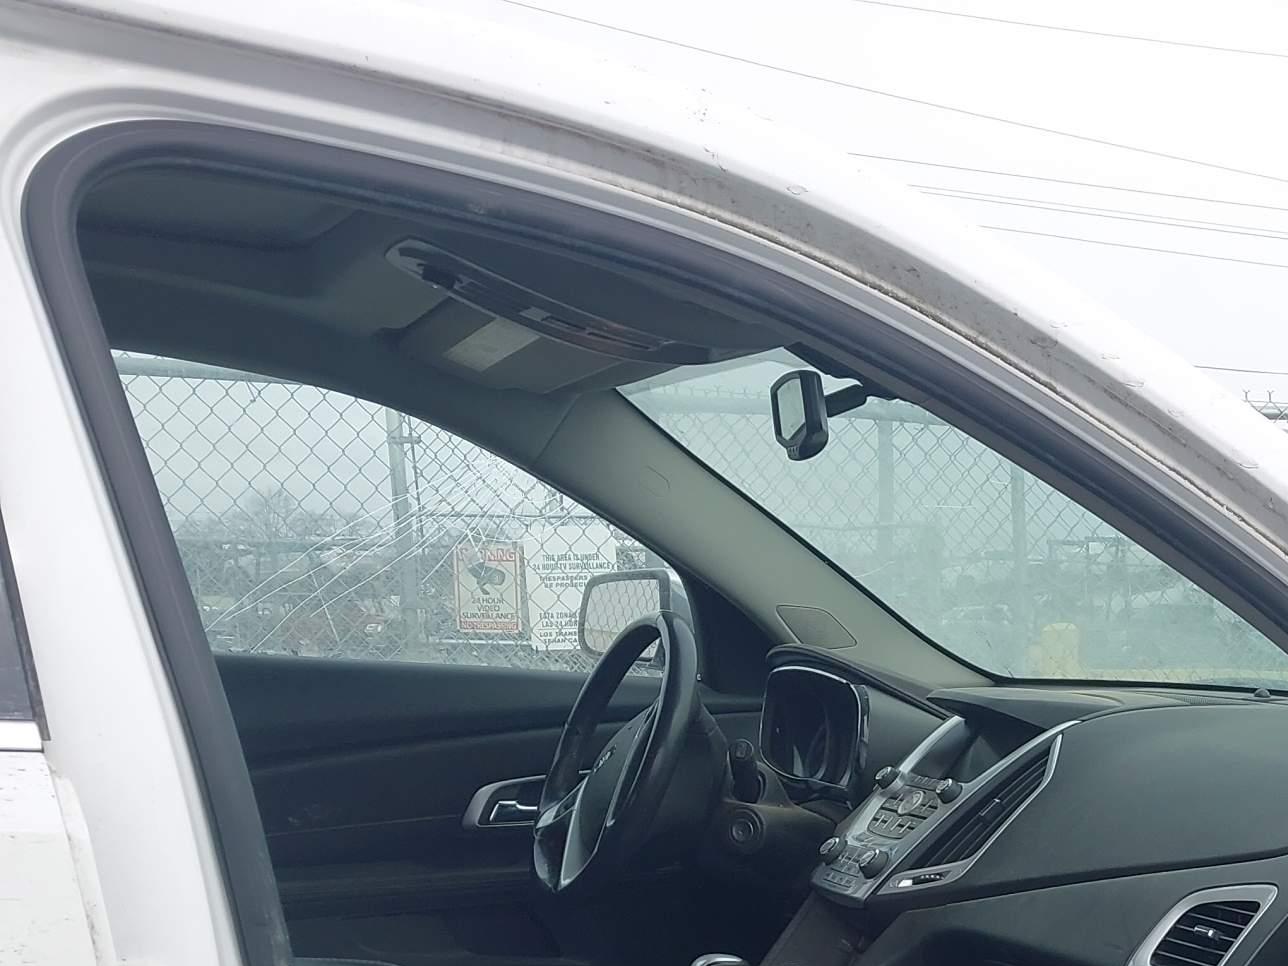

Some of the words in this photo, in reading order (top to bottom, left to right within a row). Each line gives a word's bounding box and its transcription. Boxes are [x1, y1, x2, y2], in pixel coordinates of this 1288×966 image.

[557, 553, 571, 561] AREA
[573, 553, 579, 561] IS
[580, 553, 600, 561] UNDER
[541, 563, 558, 571] HOUR
[559, 562, 567, 570] TV
[568, 561, 611, 570] SURVEILLANCE
